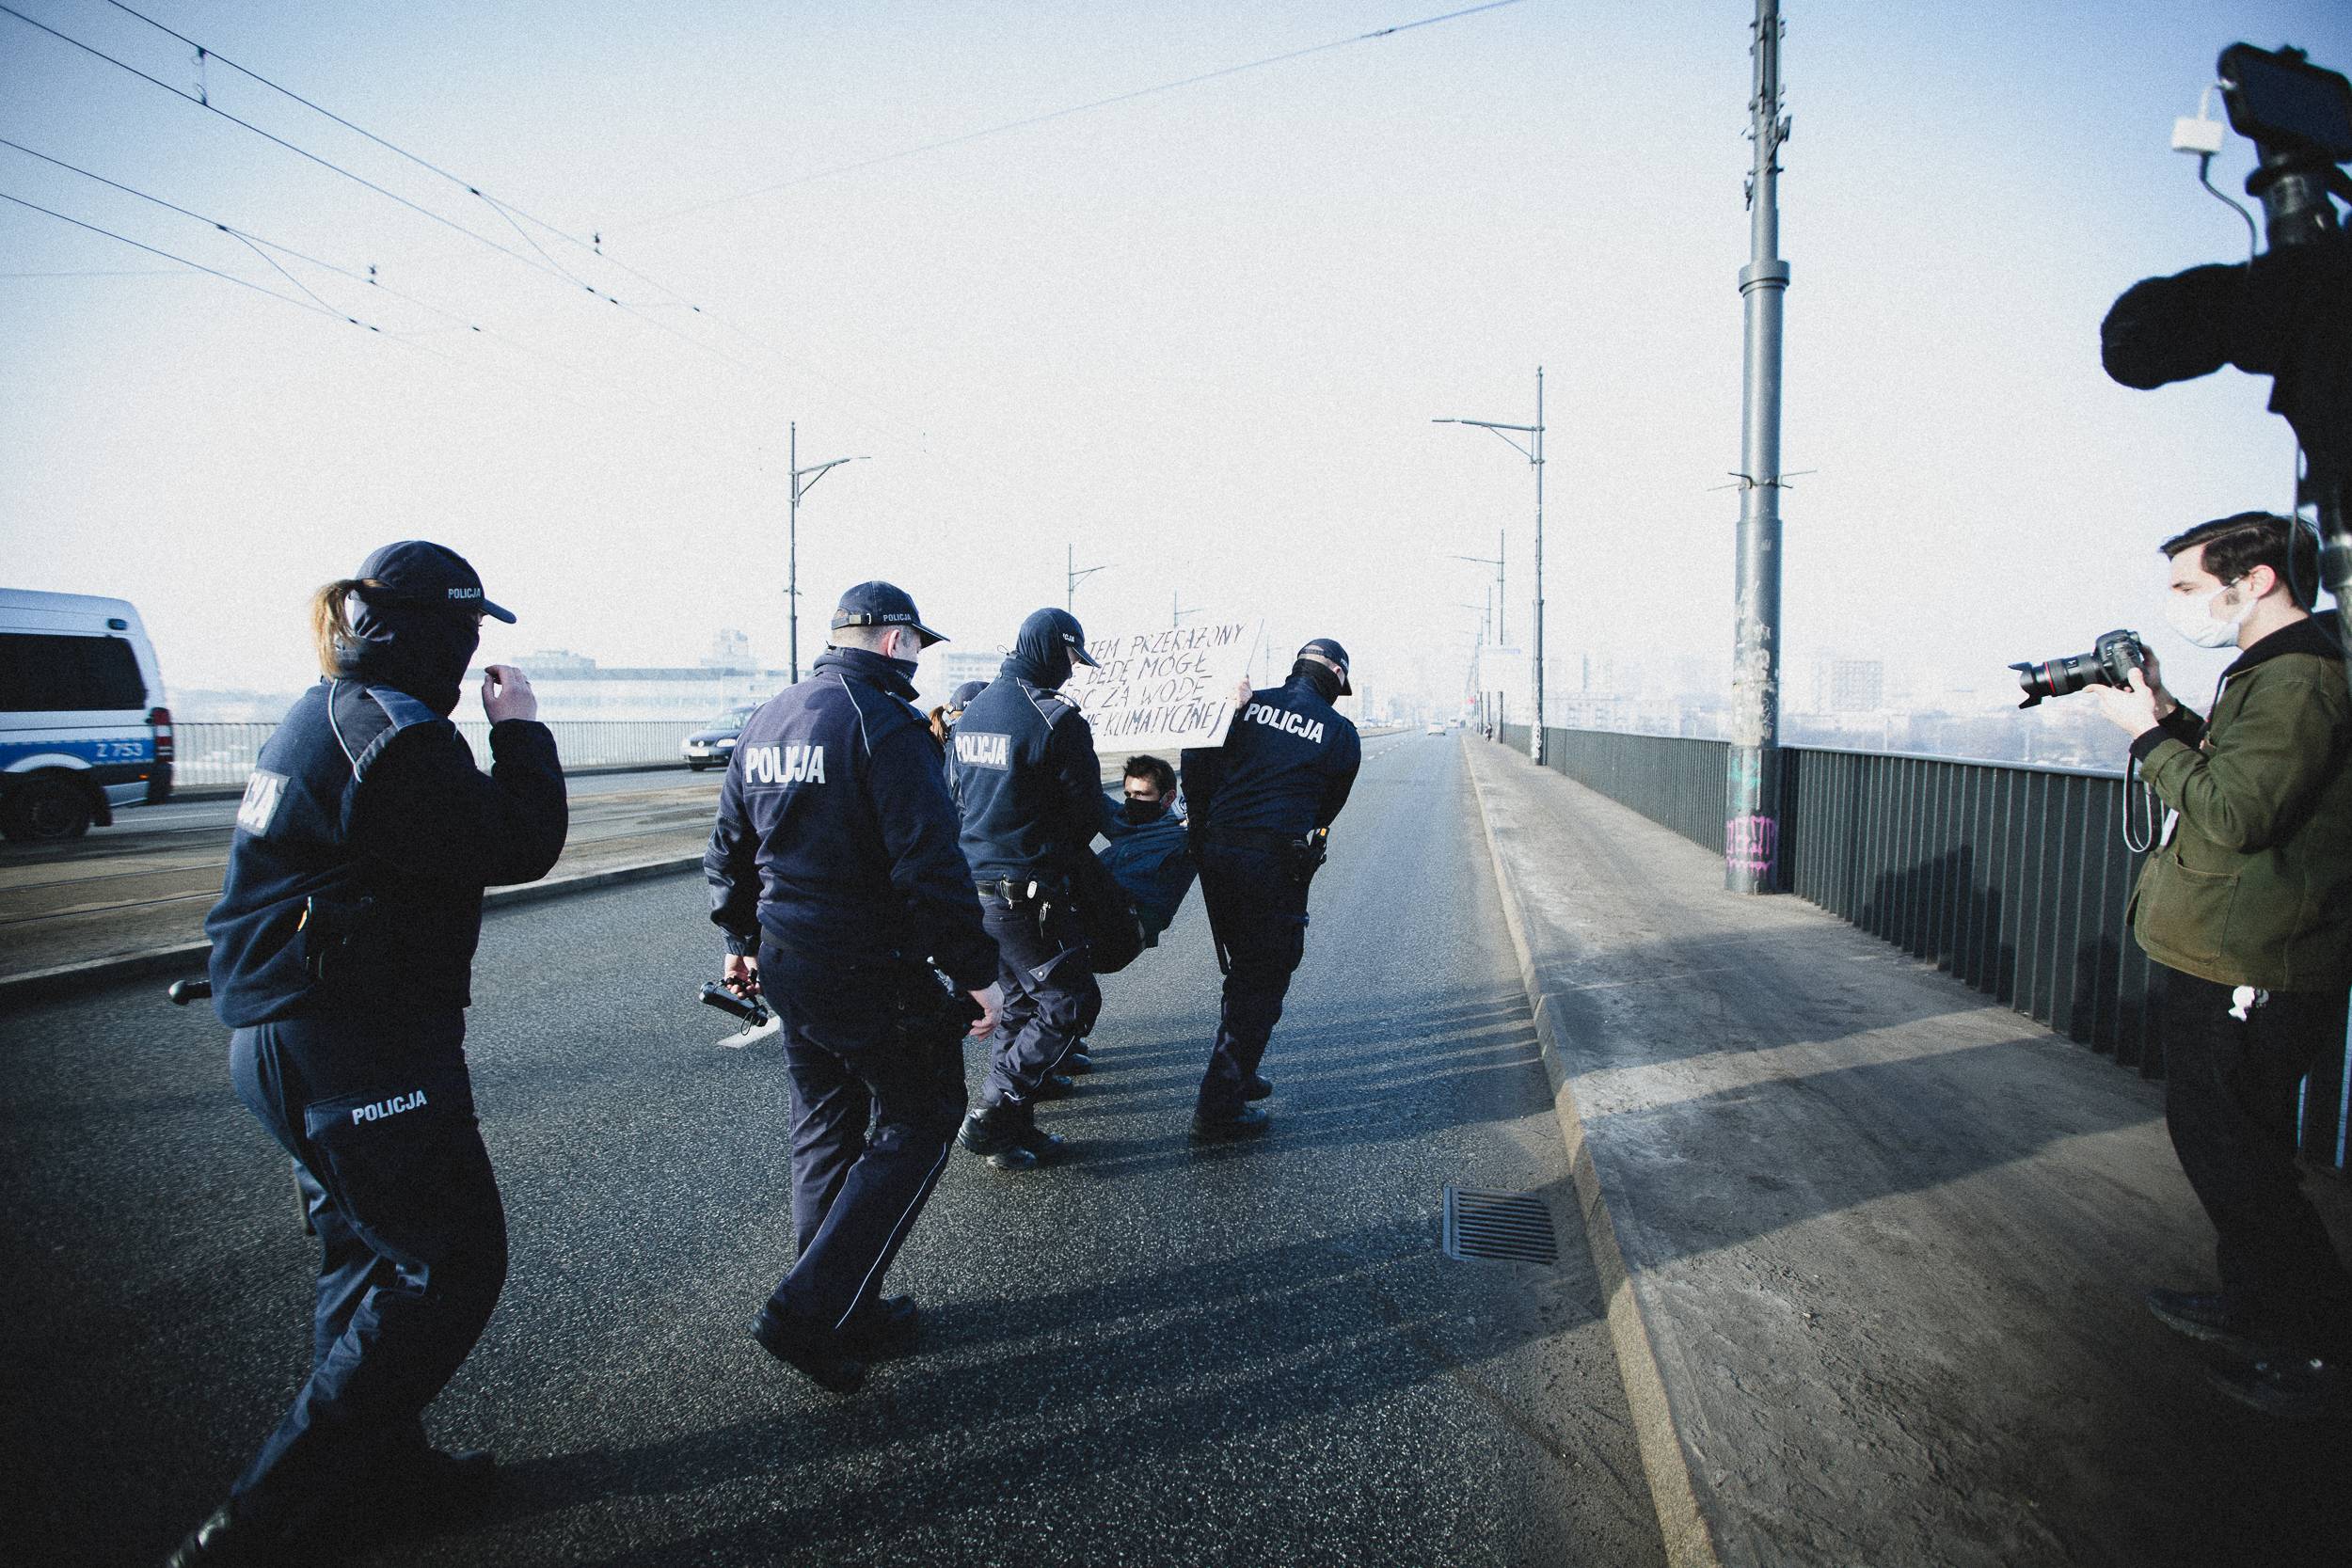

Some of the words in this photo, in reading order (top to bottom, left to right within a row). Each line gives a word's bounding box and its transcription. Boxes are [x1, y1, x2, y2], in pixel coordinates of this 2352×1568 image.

[448, 588, 481, 599] POLICJA
[882, 613, 912, 622] POLICJA
[1089, 636, 1120, 660] TEM
[1244, 703, 1325, 744] POLICJA
[96, 743, 107, 757] Z
[110, 743, 143, 757] 753
[955, 735, 1007, 765] POLICJA
[352, 1090, 427, 1125] POLICJA
